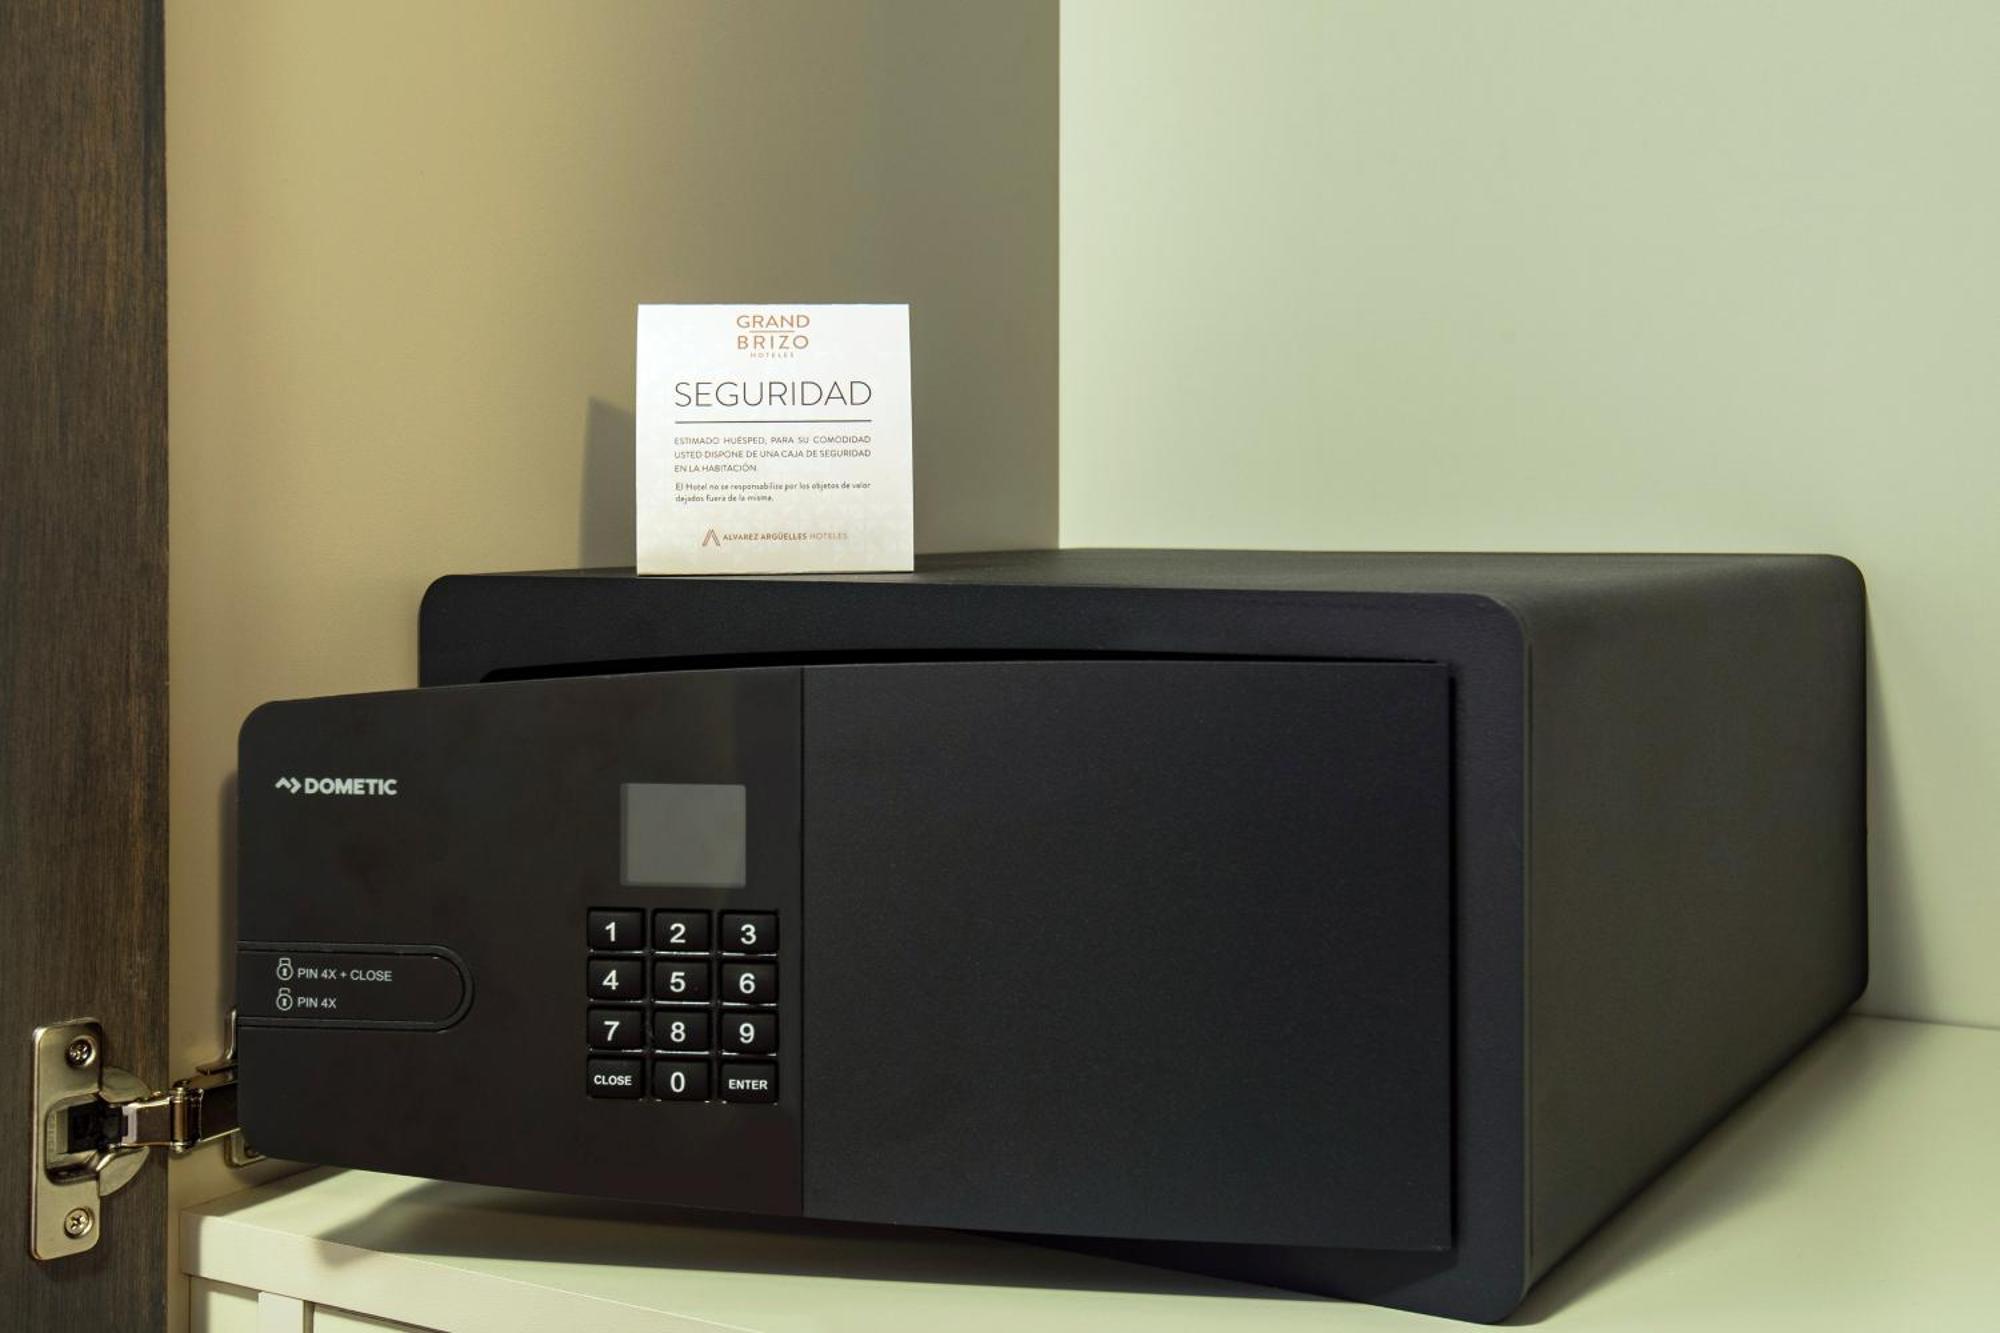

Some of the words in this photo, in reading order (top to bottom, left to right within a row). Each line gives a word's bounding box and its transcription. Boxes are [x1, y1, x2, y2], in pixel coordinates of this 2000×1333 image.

[736, 314, 810, 329] GRAND
[737, 335, 809, 350] BRIZO
[675, 381, 872, 407] SEGURIDAD
[674, 437, 720, 445] ESTIMADO
[771, 436, 794, 444] PARA
[798, 436, 809, 444] SU
[813, 435, 871, 444] COMODIDAD
[674, 451, 702, 459] USTED
[704, 450, 743, 458] DISPONE
[746, 450, 758, 458] DE
[759, 450, 779, 458] UNA
[781, 450, 804, 458] CAJA
[806, 450, 818, 458] DE
[819, 449, 871, 457] SEGURIDAD
[674, 464, 687, 472] EN
[689, 464, 700, 472] LA
[784, 483, 797, 491] por
[811, 482, 839, 491] objetos
[841, 481, 850, 489] de
[675, 494, 704, 504] dejados
[706, 494, 726, 502] fuera
[728, 494, 736, 502] de
[738, 494, 745, 502] la
[723, 533, 759, 541] ALVAREZ
[809, 532, 848, 540] HOTELES
[304, 778, 398, 796] DOMETIC
[605, 922, 616, 942] 1
[669, 923, 686, 943] 2
[740, 924, 757, 945] 3
[297, 968, 319, 979] PIN
[321, 969, 337, 980] 4X
[350, 970, 393, 981] CLOSE
[602, 970, 619, 990] 4
[669, 971, 686, 992] 5
[739, 973, 756, 994] 6
[297, 997, 319, 1008] PIN
[321, 998, 337, 1009] 4X
[603, 1020, 620, 1041] 7
[670, 1021, 686, 1042] 8
[739, 1022, 755, 1044] 9
[593, 1074, 632, 1086] CLOSE
[670, 1072, 686, 1092] 0
[728, 1079, 768, 1090] ENTER
